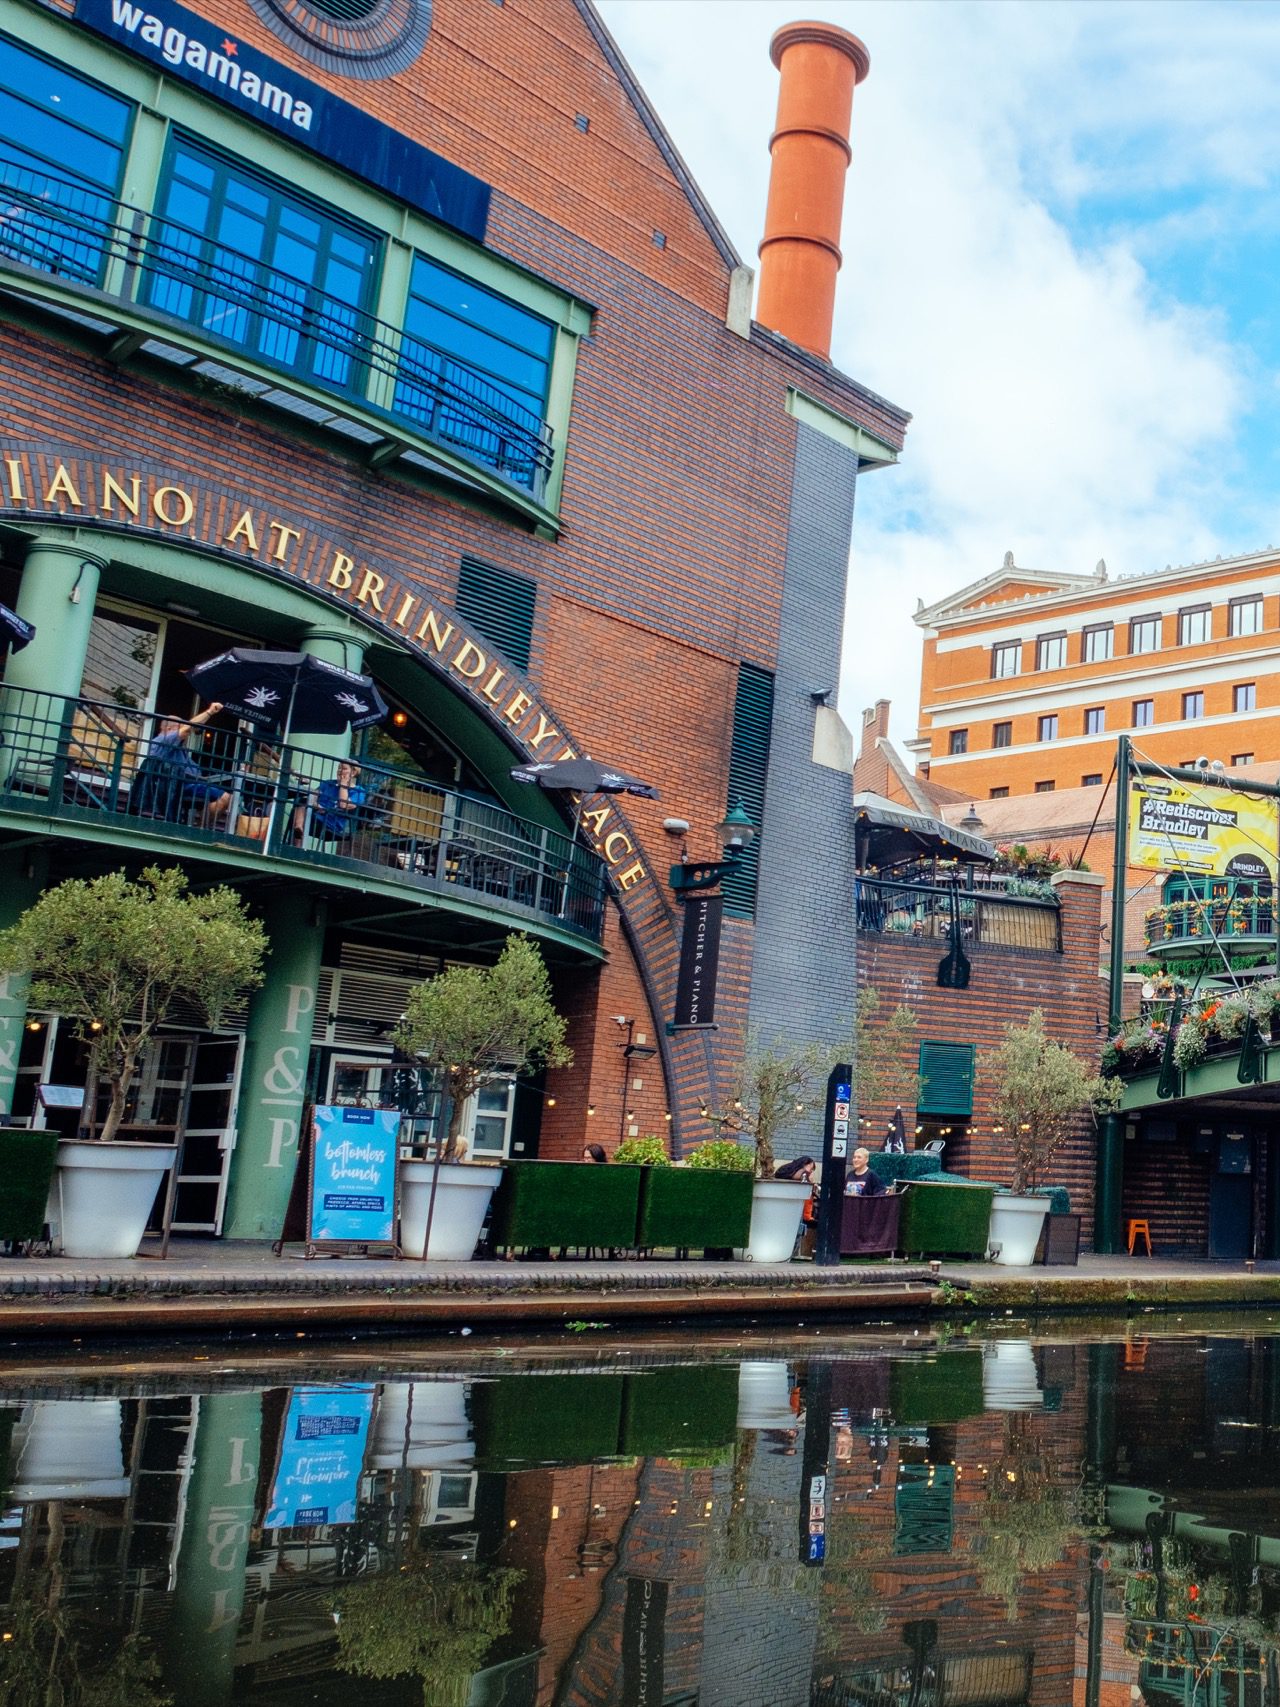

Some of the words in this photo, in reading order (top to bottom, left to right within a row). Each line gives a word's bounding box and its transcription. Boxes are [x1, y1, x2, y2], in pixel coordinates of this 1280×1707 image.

[110, 0, 314, 131] wagamama
[226, 511, 301, 562] AT
[1141, 815, 1206, 840] Brindley
[1142, 798, 1236, 825] #Rediscover
[1232, 862, 1265, 873] BRINDLEY
[695, 901, 708, 961] PITCHER
[694, 965, 702, 975] &
[280, 984, 316, 1034] P
[690, 979, 701, 1024] PIANO
[263, 1045, 304, 1095] &
[262, 1117, 300, 1168] P
[325, 1140, 386, 1169] bottomless
[331, 1162, 381, 1185] brunch
